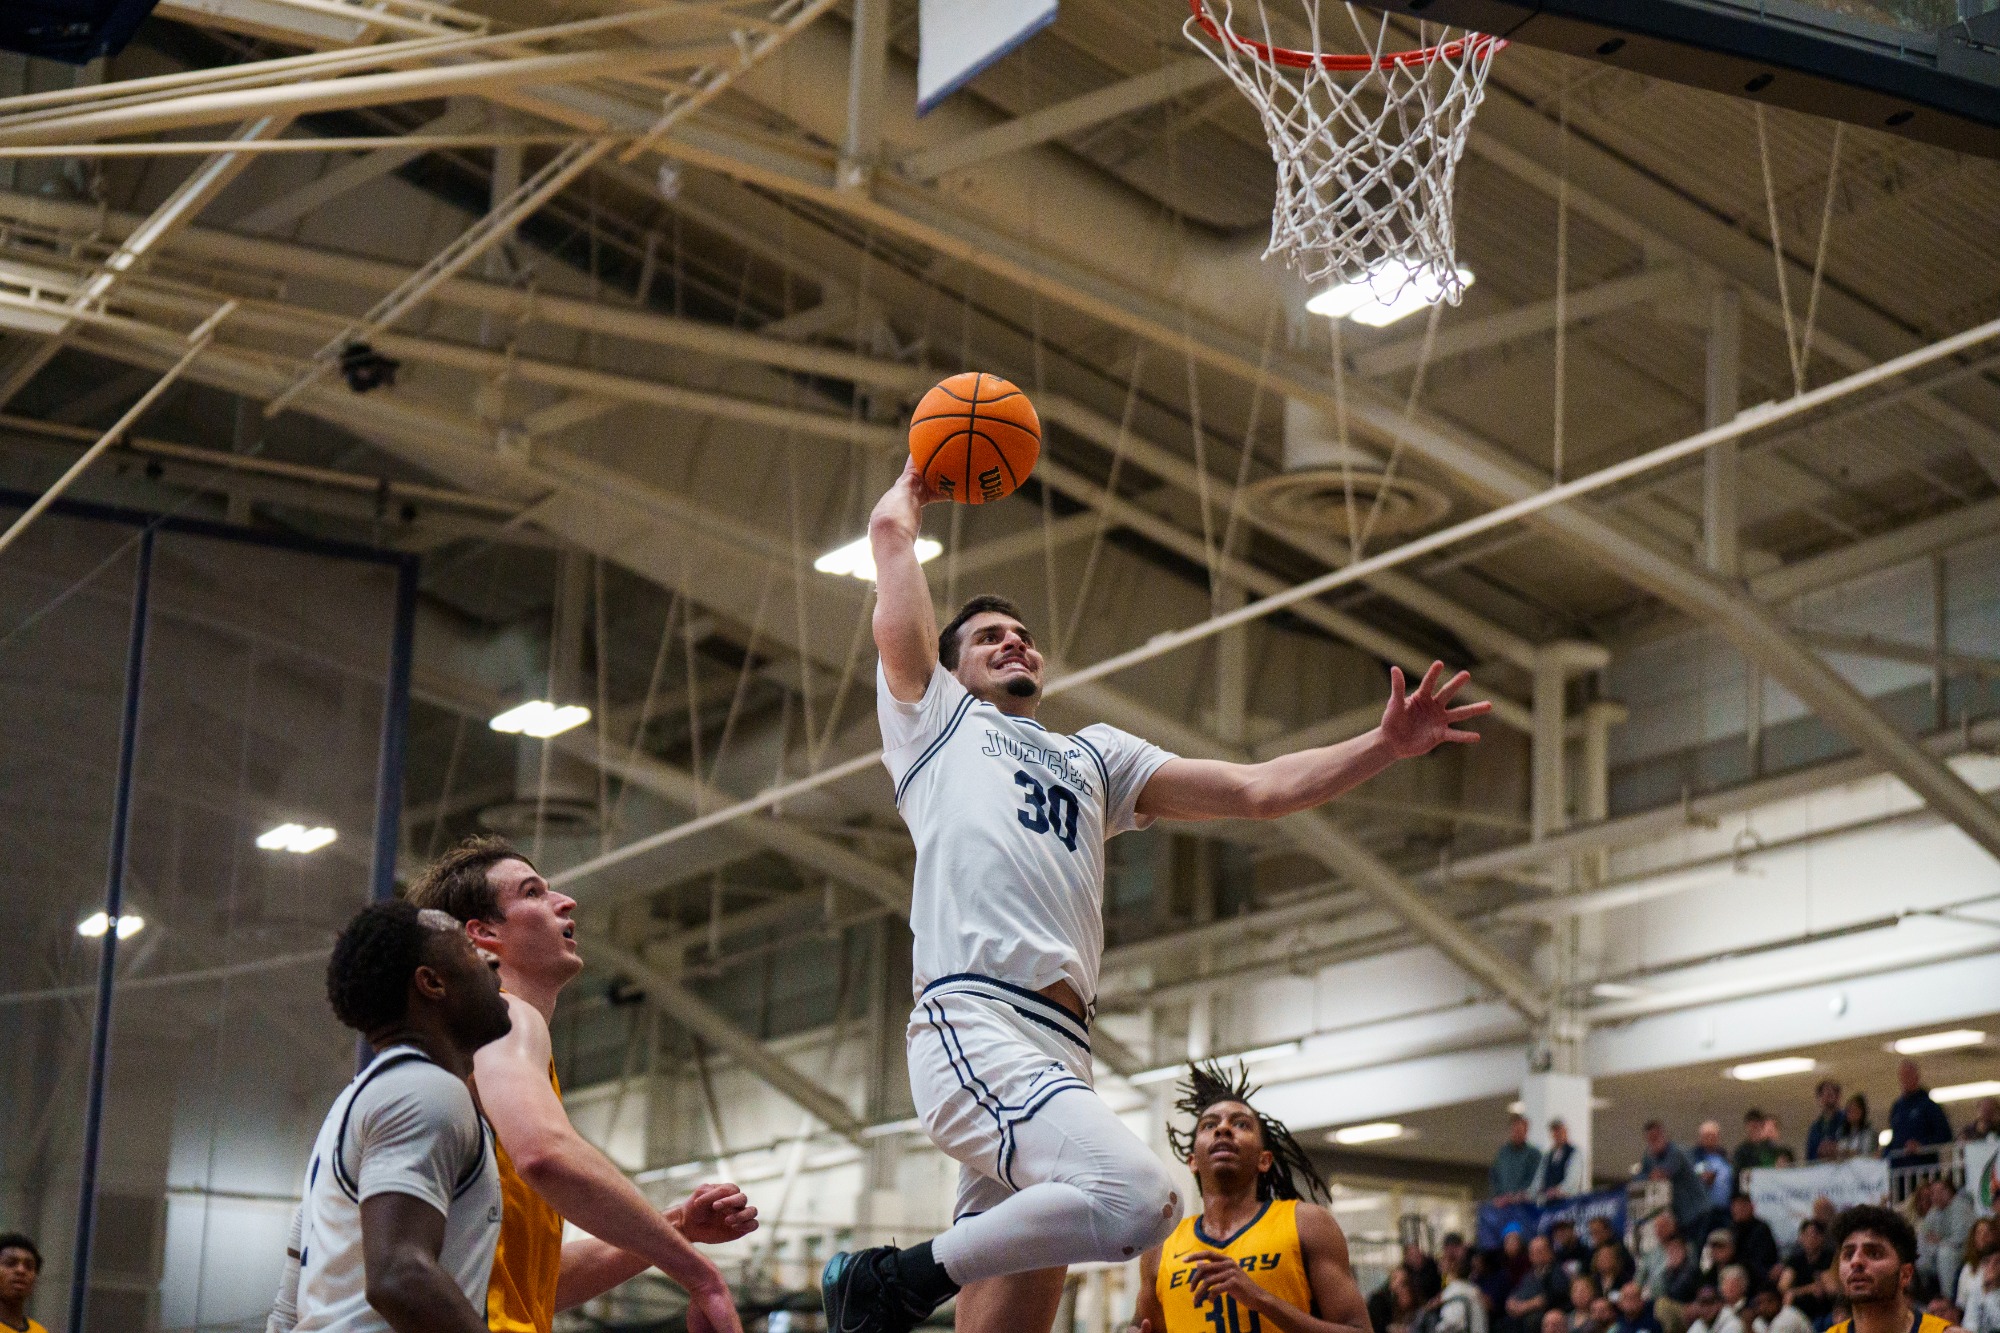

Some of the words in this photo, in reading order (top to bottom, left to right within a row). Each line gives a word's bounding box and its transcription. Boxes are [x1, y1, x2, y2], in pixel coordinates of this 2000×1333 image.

[977, 465, 1005, 502] Wil
[1013, 769, 1079, 852] 30
[1169, 1252, 1281, 1290] ERY
[1193, 1287, 1262, 1333] 30
